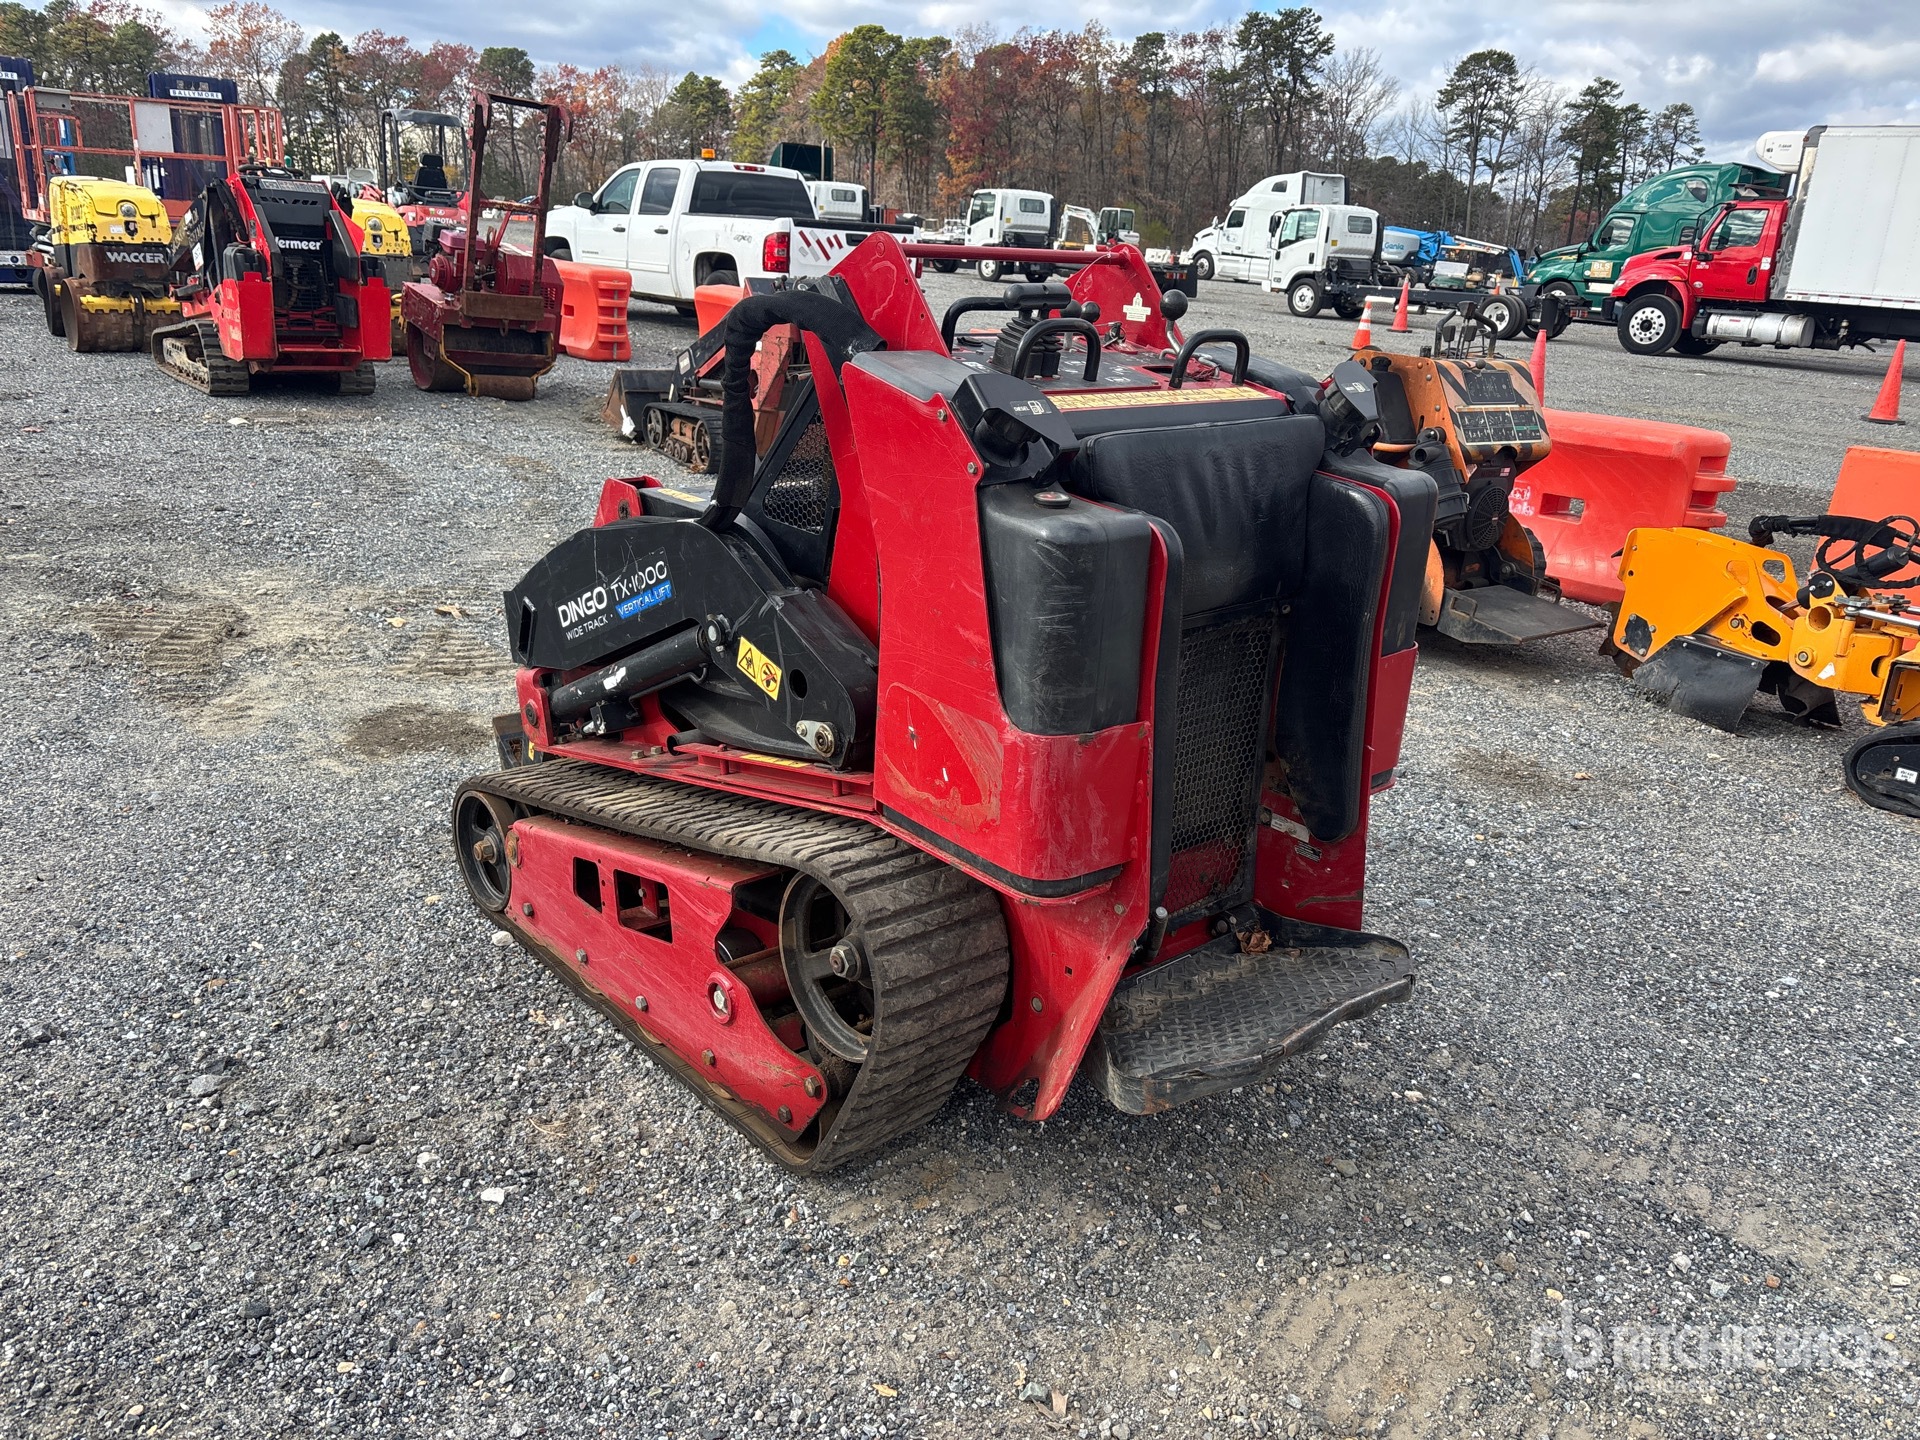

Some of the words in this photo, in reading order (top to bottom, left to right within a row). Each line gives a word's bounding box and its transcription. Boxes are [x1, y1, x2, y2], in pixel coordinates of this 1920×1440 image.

[172, 90, 220, 98] BALLYMORE
[1384, 242, 1405, 250] Genie
[106, 251, 166, 264] WACKER
[1593, 261, 1611, 270] BLS
[557, 586, 608, 628] DINGO
[565, 626, 584, 640] WIDE
[583, 613, 609, 633] TRACK
[618, 594, 655, 616] VERTICAL
[654, 584, 671, 599] LIFT
